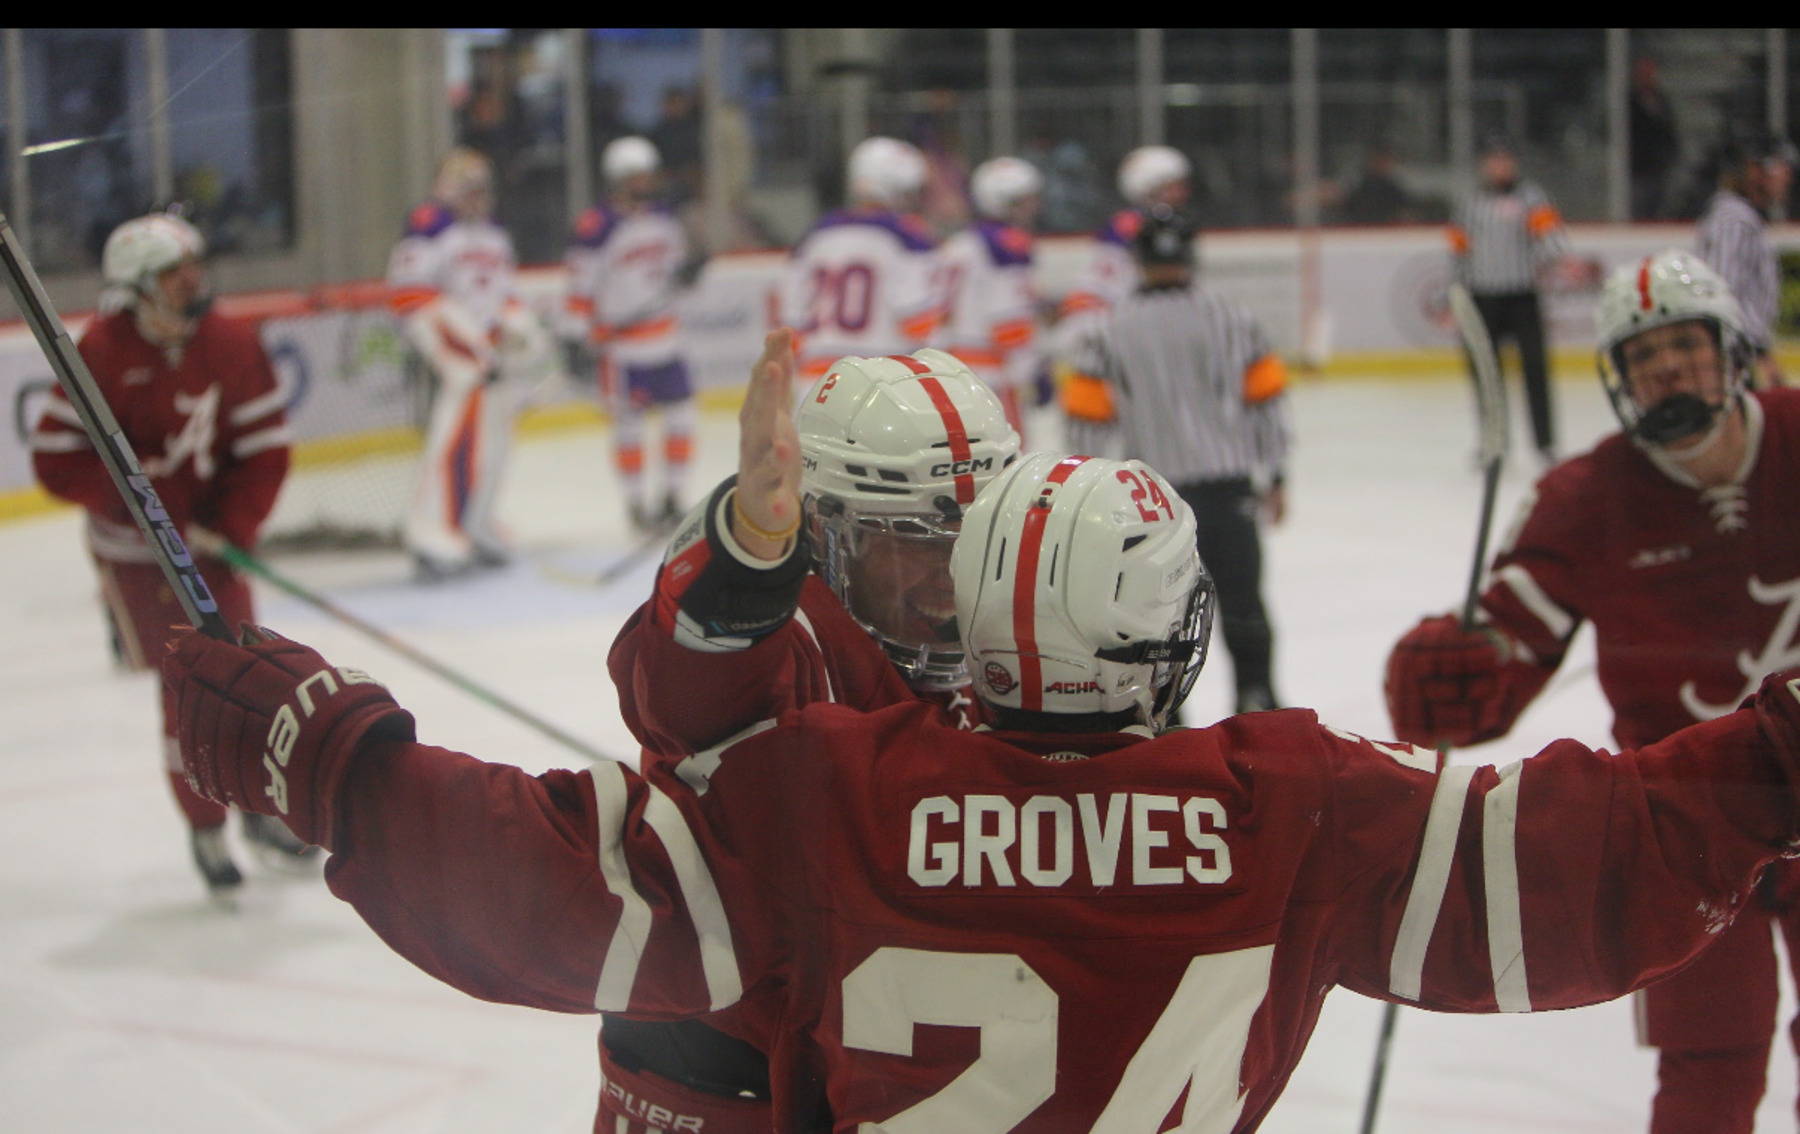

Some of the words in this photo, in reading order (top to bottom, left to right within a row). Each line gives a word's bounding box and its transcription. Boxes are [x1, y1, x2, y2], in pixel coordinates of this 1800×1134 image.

[815, 372, 842, 404] 2
[930, 457, 994, 478] CCM
[1116, 469, 1175, 523] 24
[1044, 681, 1105, 695] ACHA
[906, 792, 1233, 888] GROVES
[841, 943, 1276, 1134] 24
